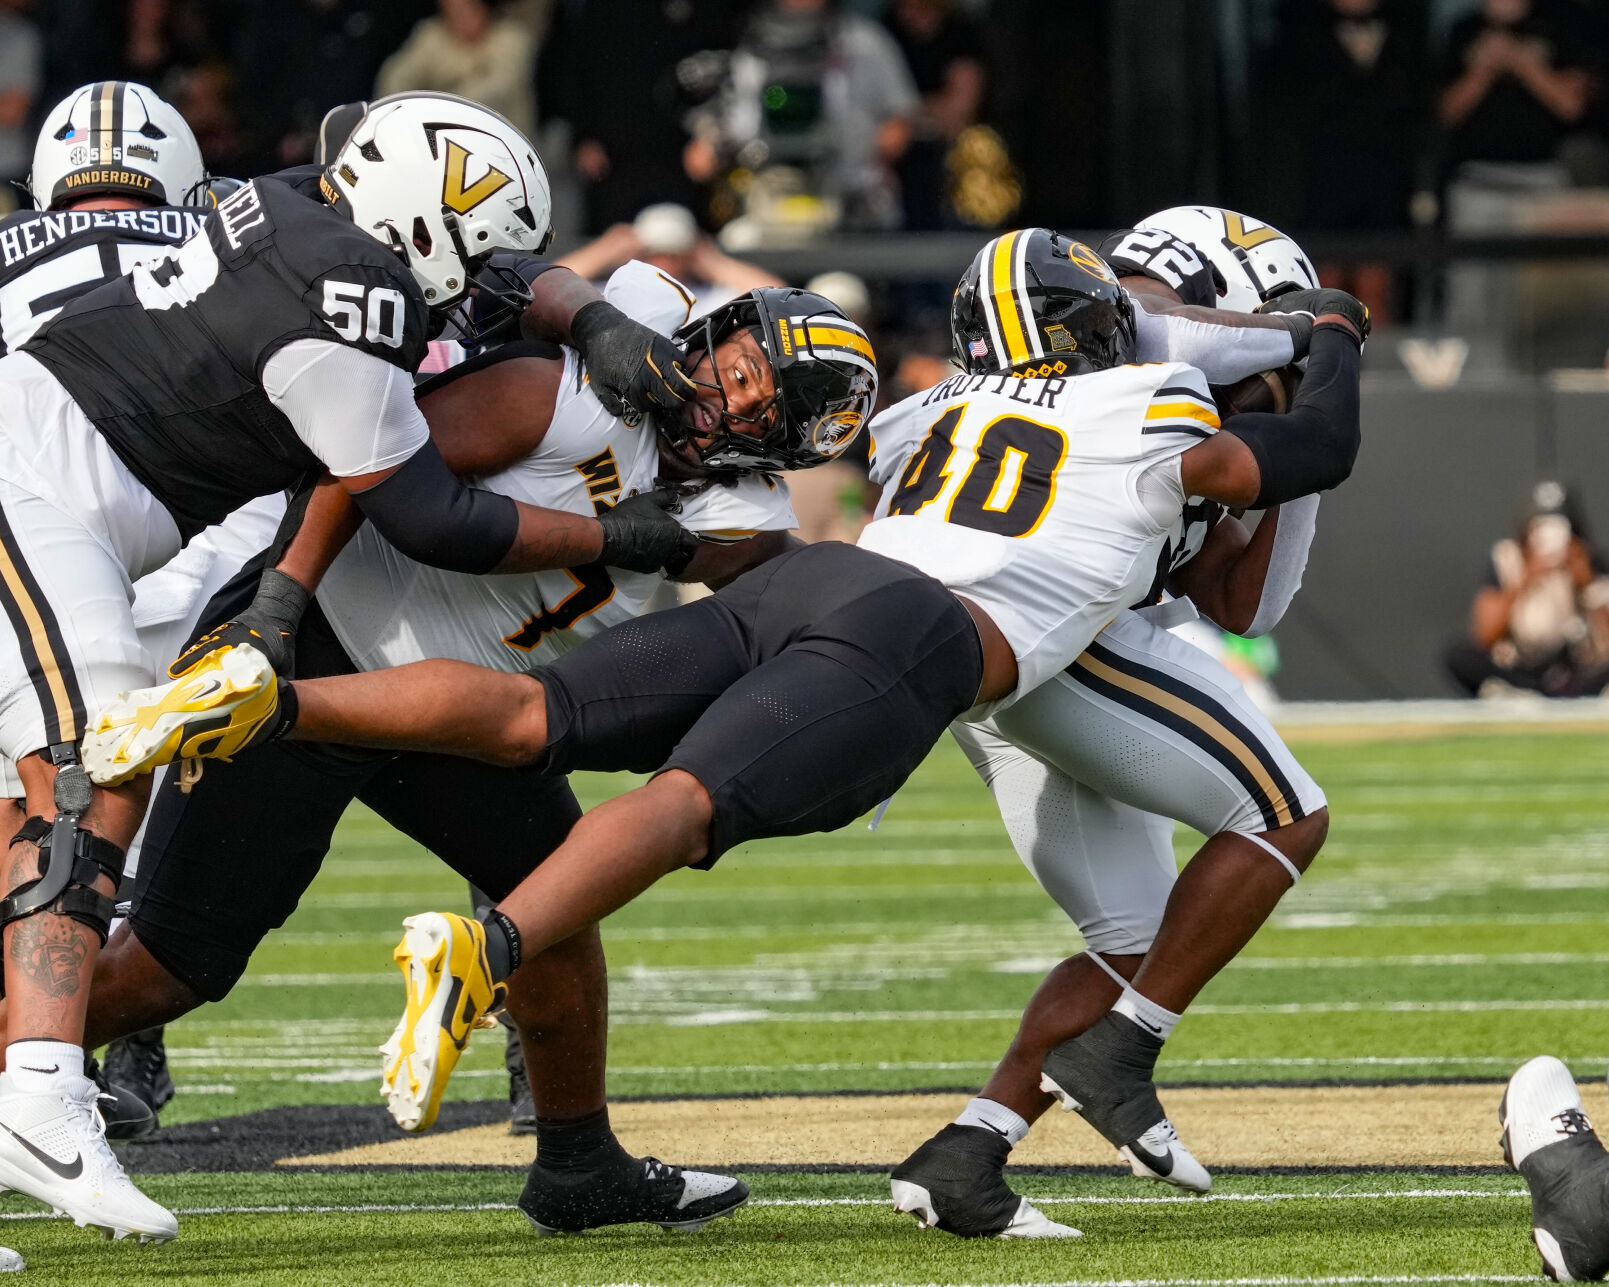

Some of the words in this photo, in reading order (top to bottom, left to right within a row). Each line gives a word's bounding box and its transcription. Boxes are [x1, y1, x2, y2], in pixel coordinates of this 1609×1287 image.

[65, 170, 152, 189] VANDERBILT
[320, 174, 340, 204] BILT
[442, 136, 515, 216] V
[0, 210, 207, 267] HENDERSON
[1111, 227, 1204, 290] 22
[322, 279, 406, 349] 50
[778, 318, 793, 356] MIZZOU
[921, 373, 1067, 409] TROTTER
[886, 401, 1070, 539] 40
